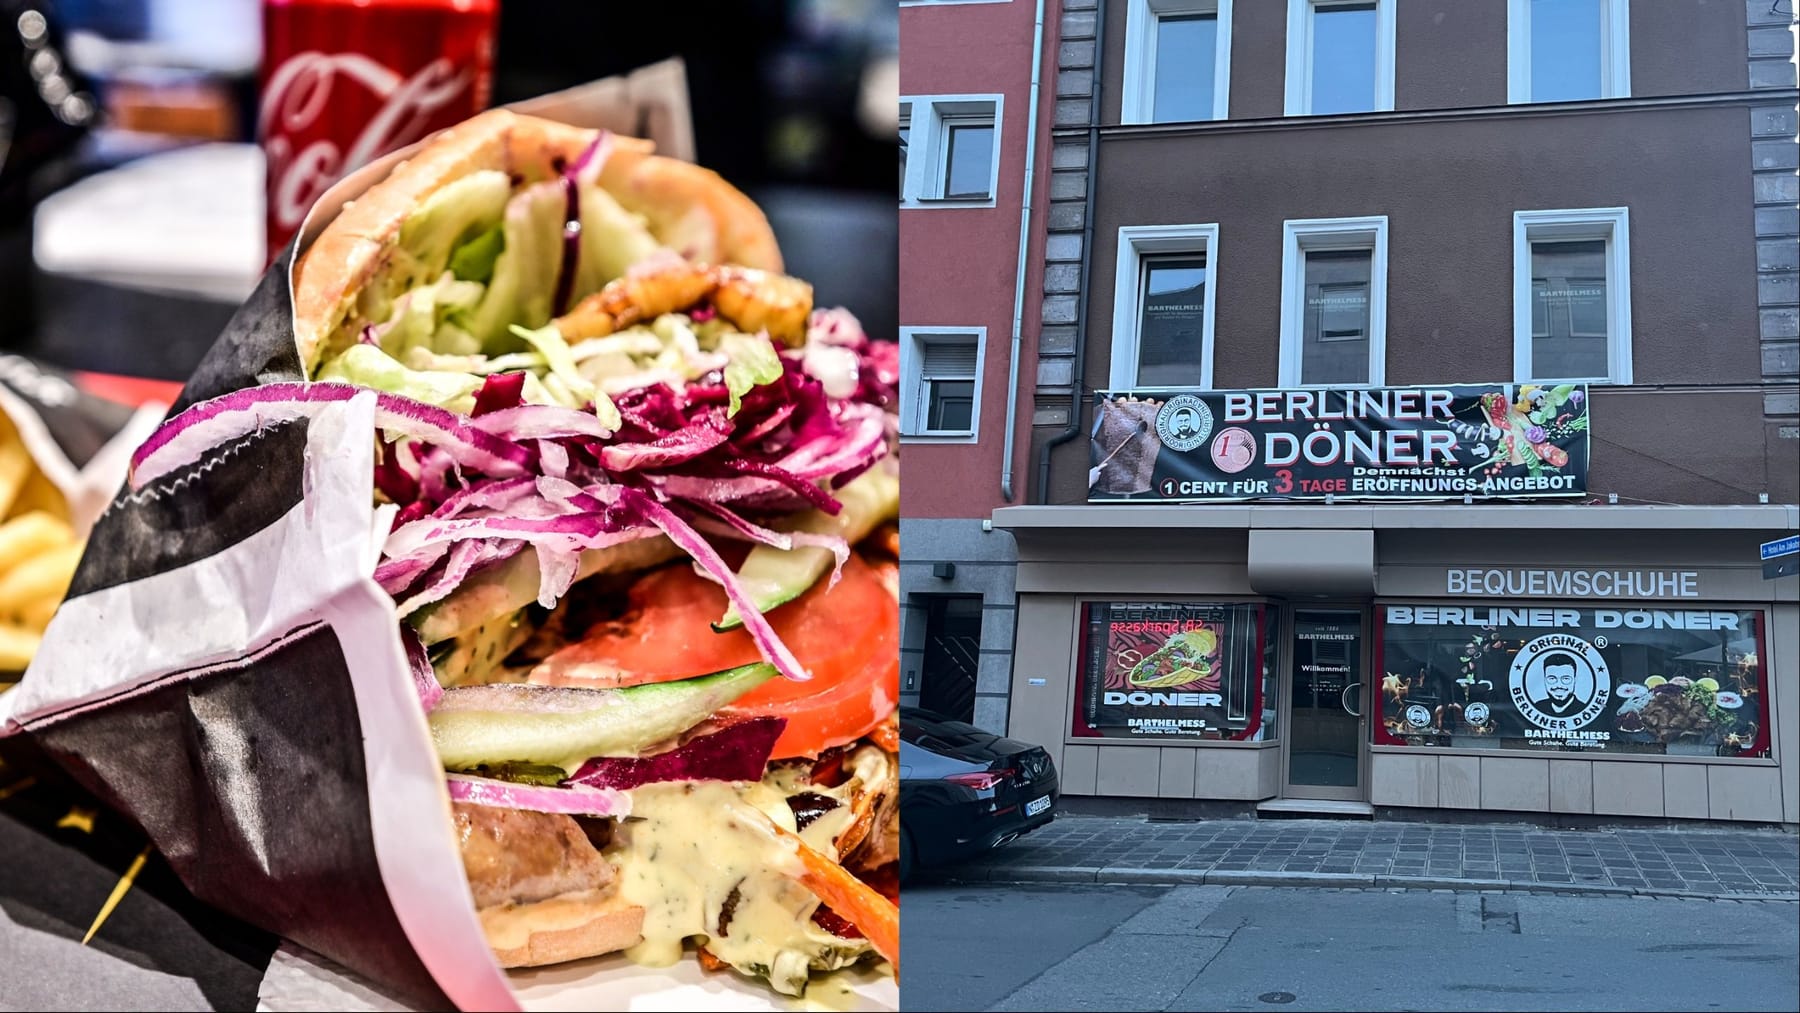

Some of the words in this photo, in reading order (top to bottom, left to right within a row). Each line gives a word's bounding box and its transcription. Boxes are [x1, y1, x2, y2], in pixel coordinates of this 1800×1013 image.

[1223, 389, 1456, 424] BERLINER
[1218, 435, 1231, 457] 1
[1264, 422, 1459, 467] DÖNER
[1164, 481, 1173, 494] 1
[1180, 481, 1227, 494] CENT
[1232, 478, 1269, 494] FÜR
[1274, 469, 1294, 493] 3
[1299, 479, 1347, 492] TAGE
[1353, 466, 1466, 476] Demnächst
[1447, 569, 1699, 597] BEQUEMSCHUHE
[1109, 609, 1225, 621] BERLINER
[1387, 606, 1581, 628] BERLINER
[1529, 636, 1590, 656] ORIGINAL
[1301, 664, 1351, 673] Willkommen!
[1104, 690, 1222, 706] DÖNER
[1512, 687, 1567, 729] BERLINER
[1573, 689, 1608, 727] DÖNER
[1128, 718, 1206, 728] BARTHELMESS
[1524, 729, 1611, 740] BARTHELMESS
